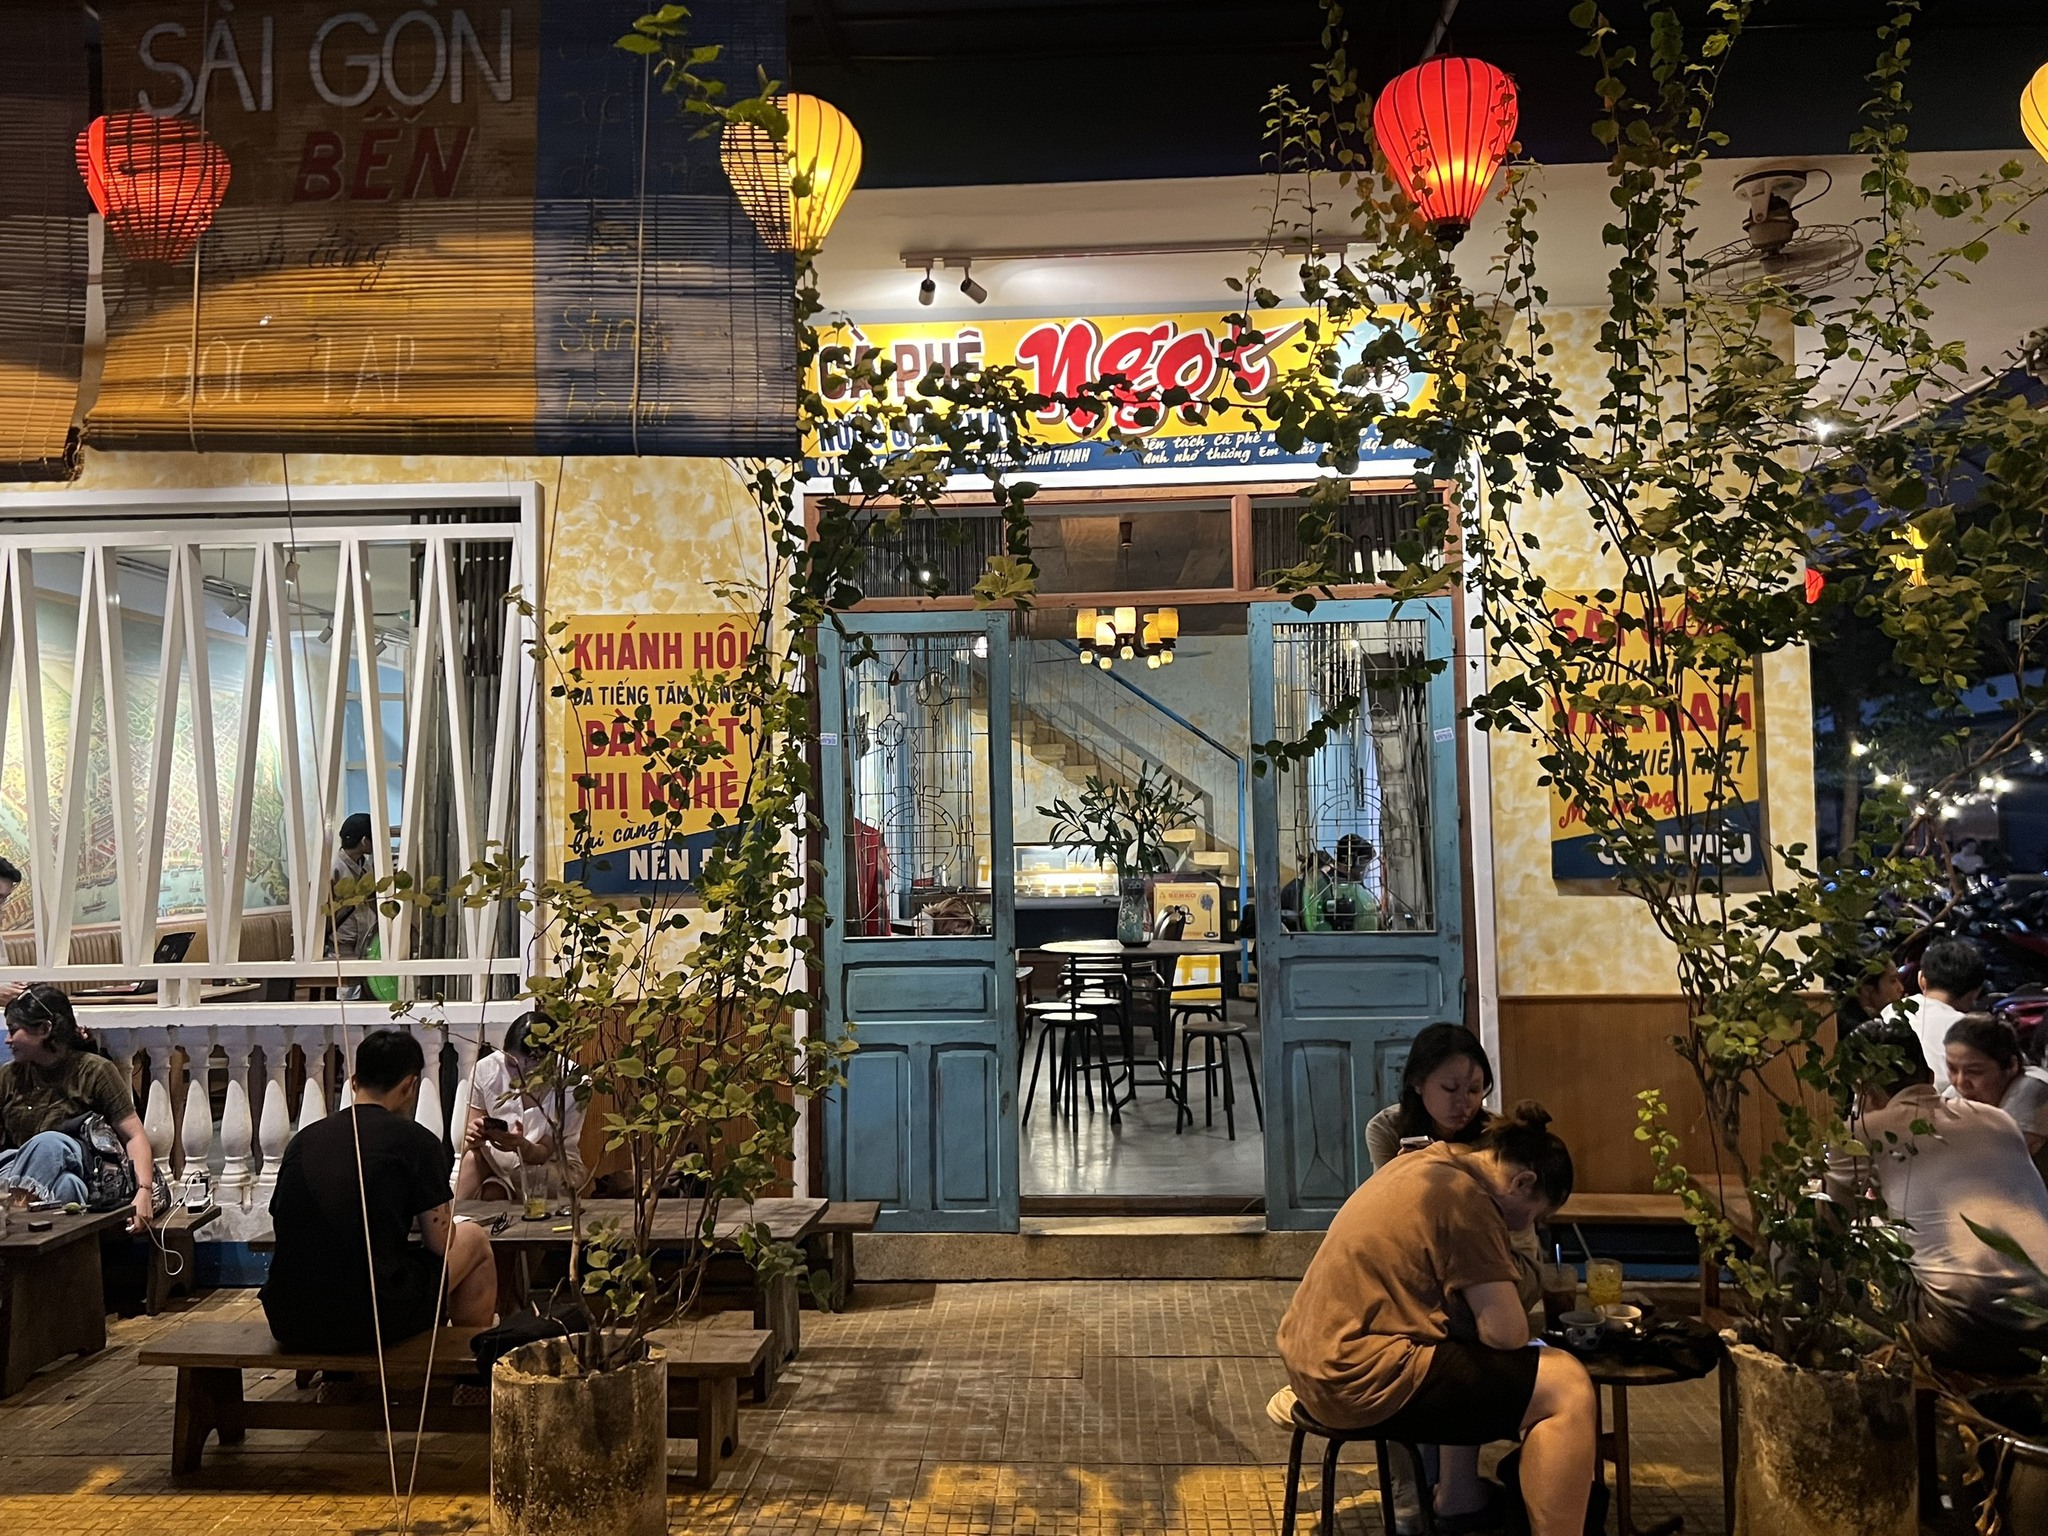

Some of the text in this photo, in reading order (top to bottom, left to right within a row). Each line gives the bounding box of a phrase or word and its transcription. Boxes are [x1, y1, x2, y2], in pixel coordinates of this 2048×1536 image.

[293, 105, 475, 201] BẾN
[895, 329, 983, 397] PHÊ
[1053, 447, 1091, 467] THẠNH
[1143, 451, 1169, 464] Anh
[1258, 446, 1280, 457] Em
[1173, 435, 1208, 449] tách
[573, 620, 683, 671] KHÁNH
[598, 677, 649, 706] TIẾNG
[654, 680, 694, 706] TĂM
[572, 772, 629, 819] THỊ
